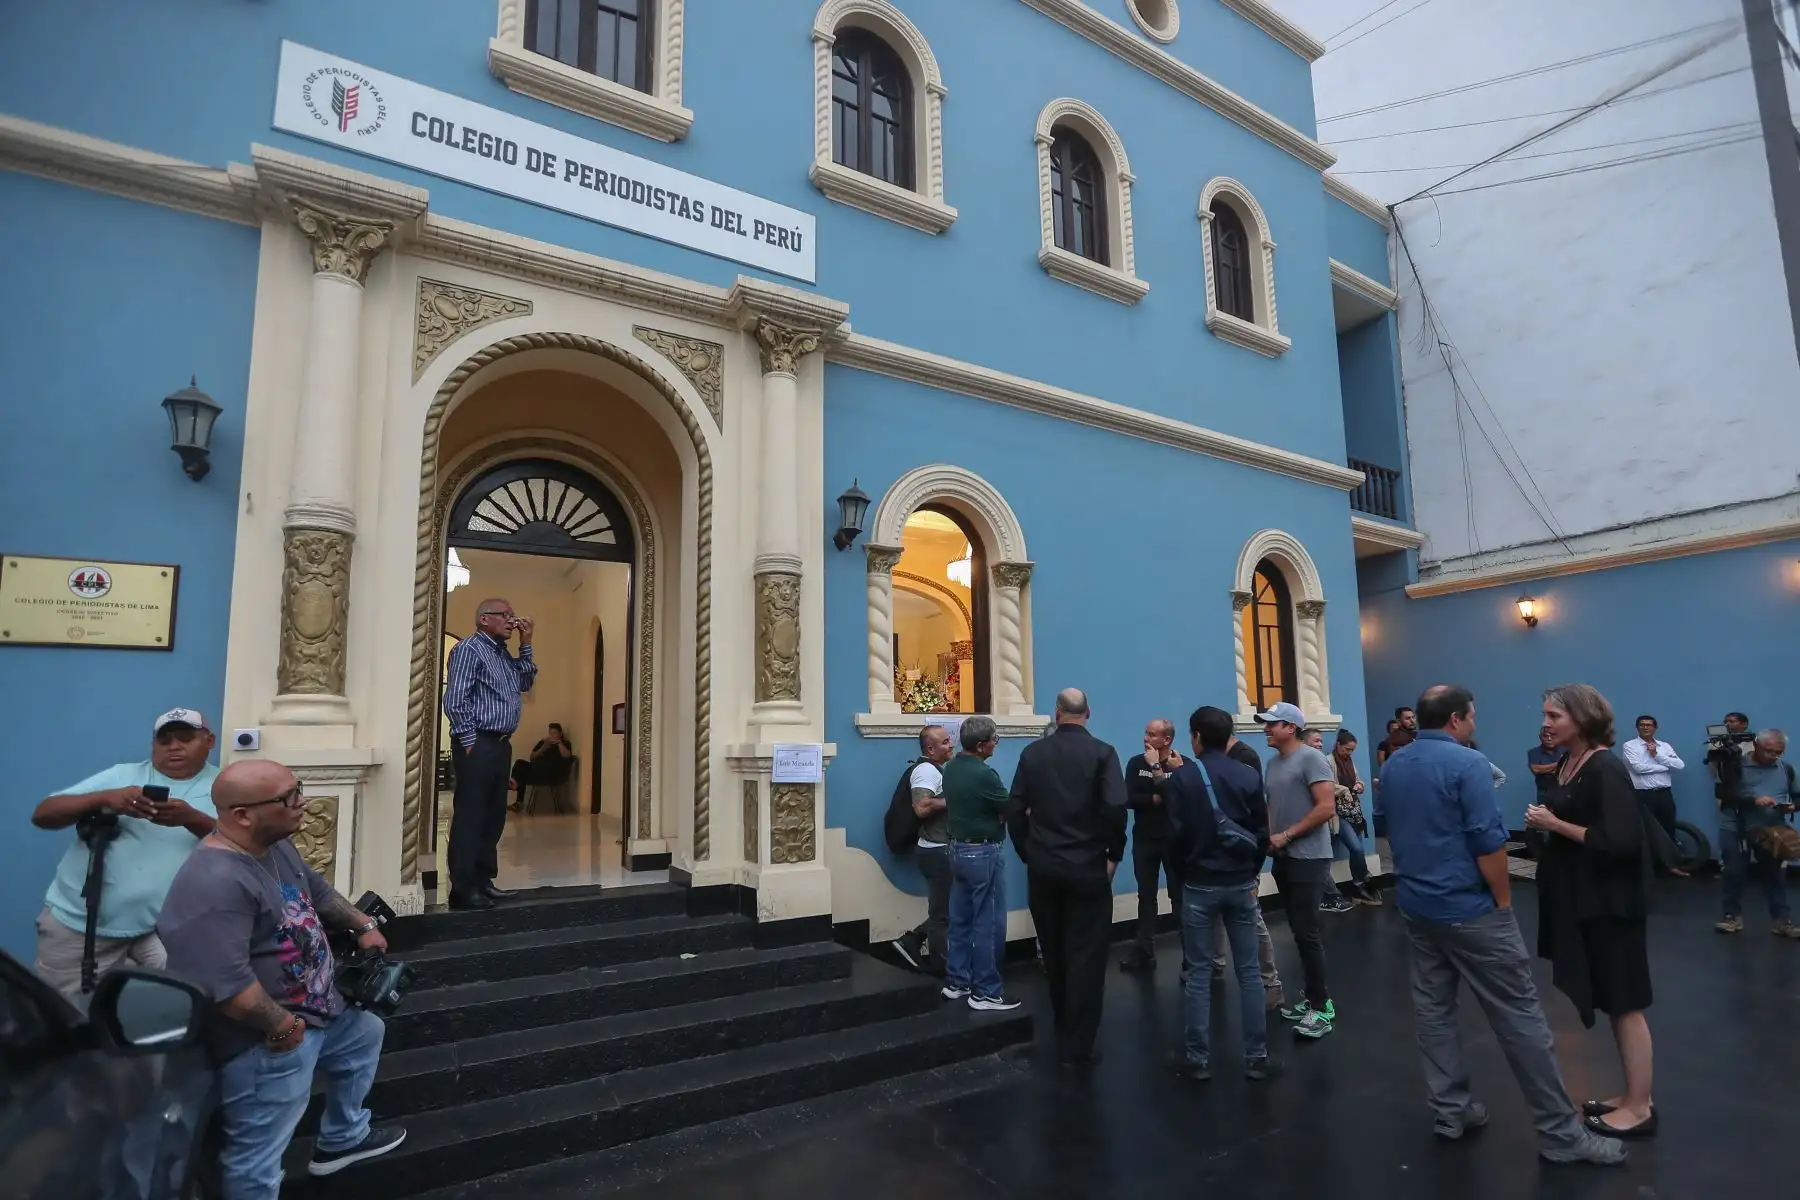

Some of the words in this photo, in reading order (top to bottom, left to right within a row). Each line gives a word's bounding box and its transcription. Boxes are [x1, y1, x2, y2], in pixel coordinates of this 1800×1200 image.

[305, 72, 319, 85] DE
[318, 67, 384, 103] PERIODISTAS
[302, 84, 329, 126] COLEGIO
[376, 104, 387, 121] DEL
[411, 111, 518, 166] COLEGIO
[525, 146, 557, 178] DE
[563, 158, 705, 224] PERIODISTAS
[710, 205, 747, 237] DEL
[753, 218, 803, 254] PERÚ
[14, 597, 54, 605] COLEGIO
[70, 600, 126, 609] PERIODISTAS
